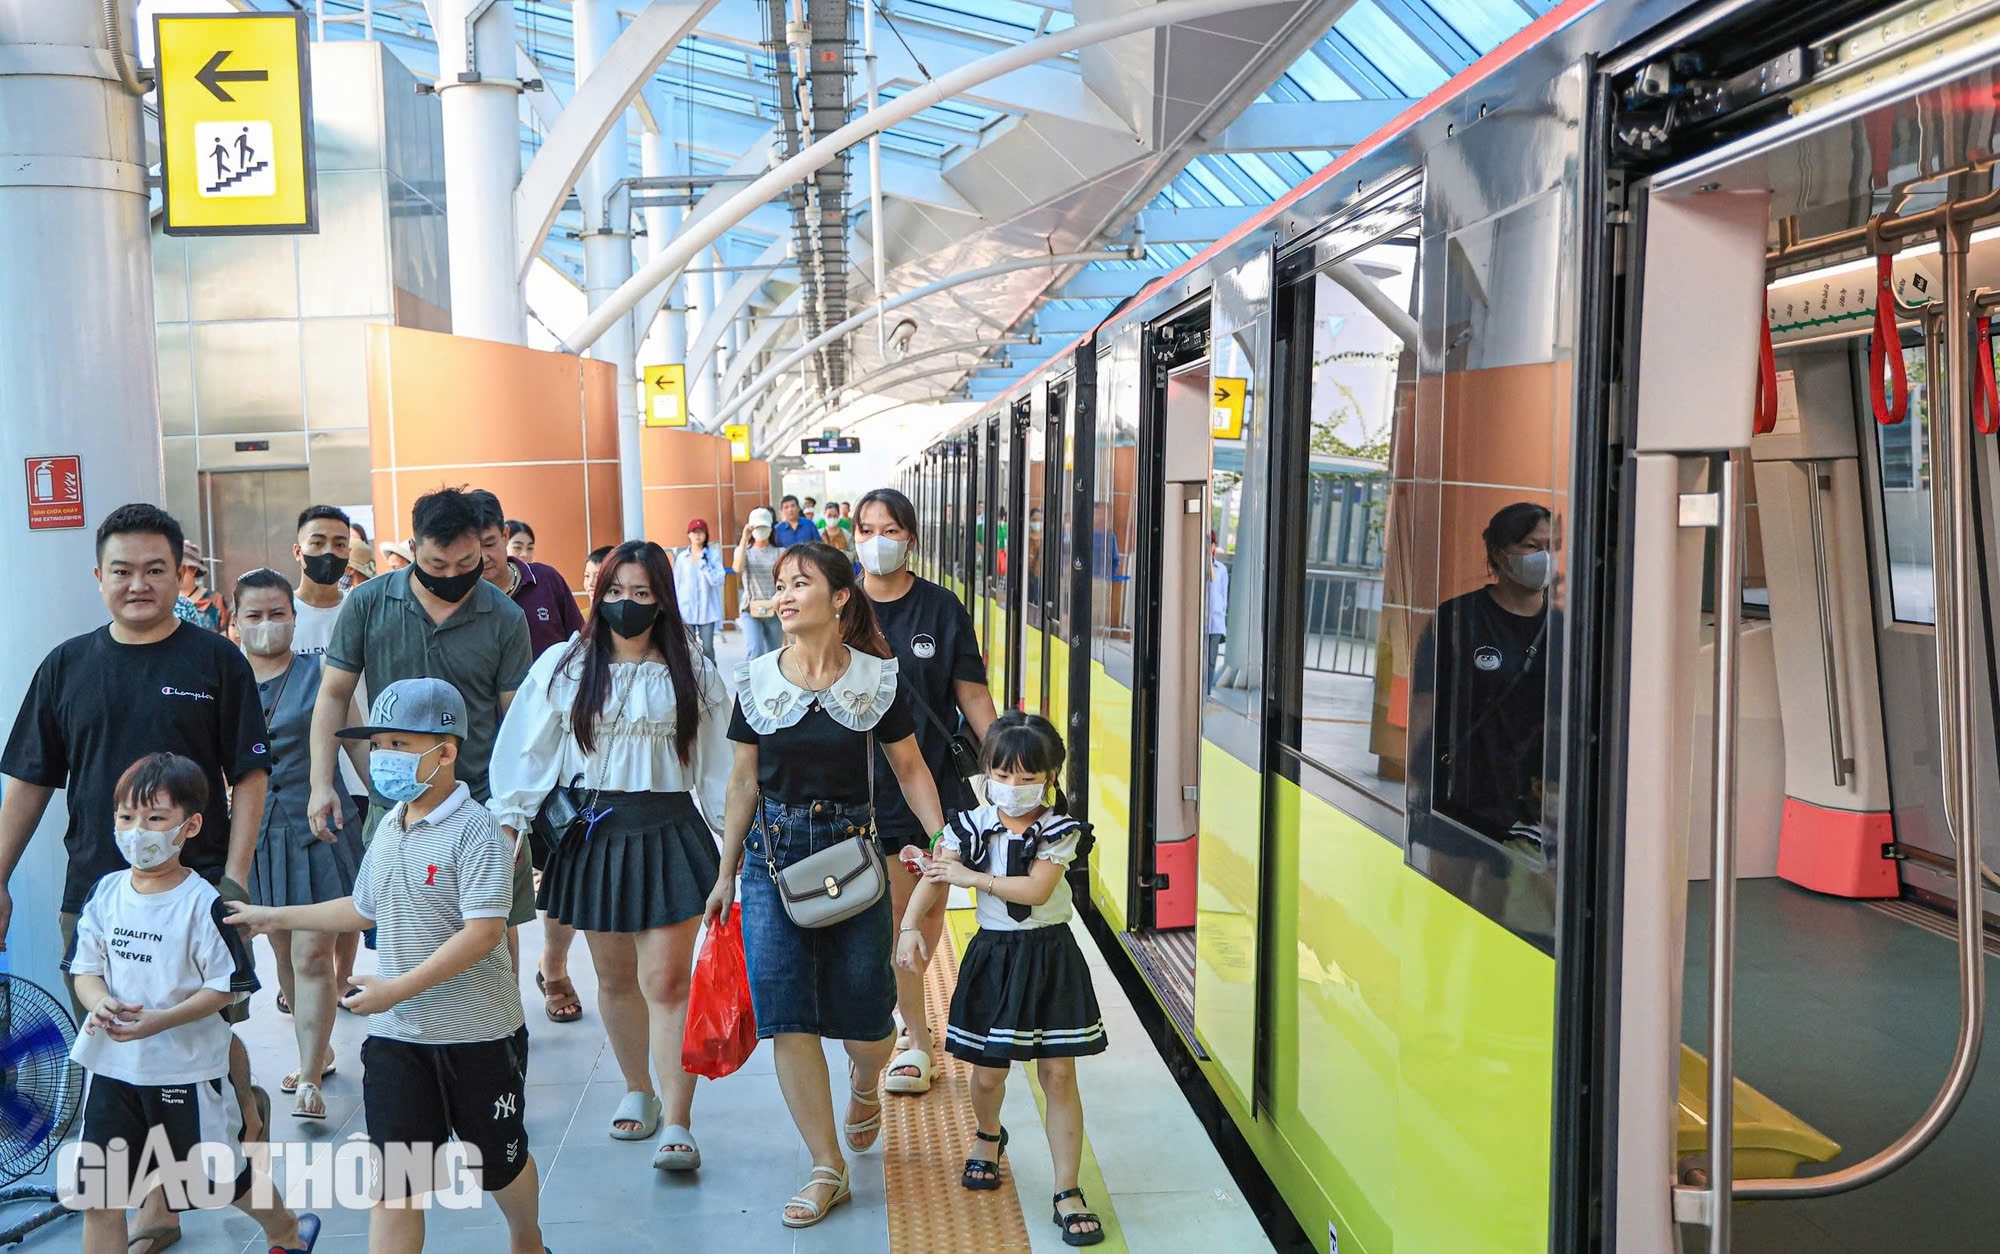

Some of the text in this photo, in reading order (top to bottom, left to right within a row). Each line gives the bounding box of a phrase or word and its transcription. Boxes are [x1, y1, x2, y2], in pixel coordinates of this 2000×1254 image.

[161, 686, 214, 701] Champion
[113, 927, 163, 942] QUALITYN
[111, 938, 130, 948] BOY
[493, 1092, 517, 1120] NY
